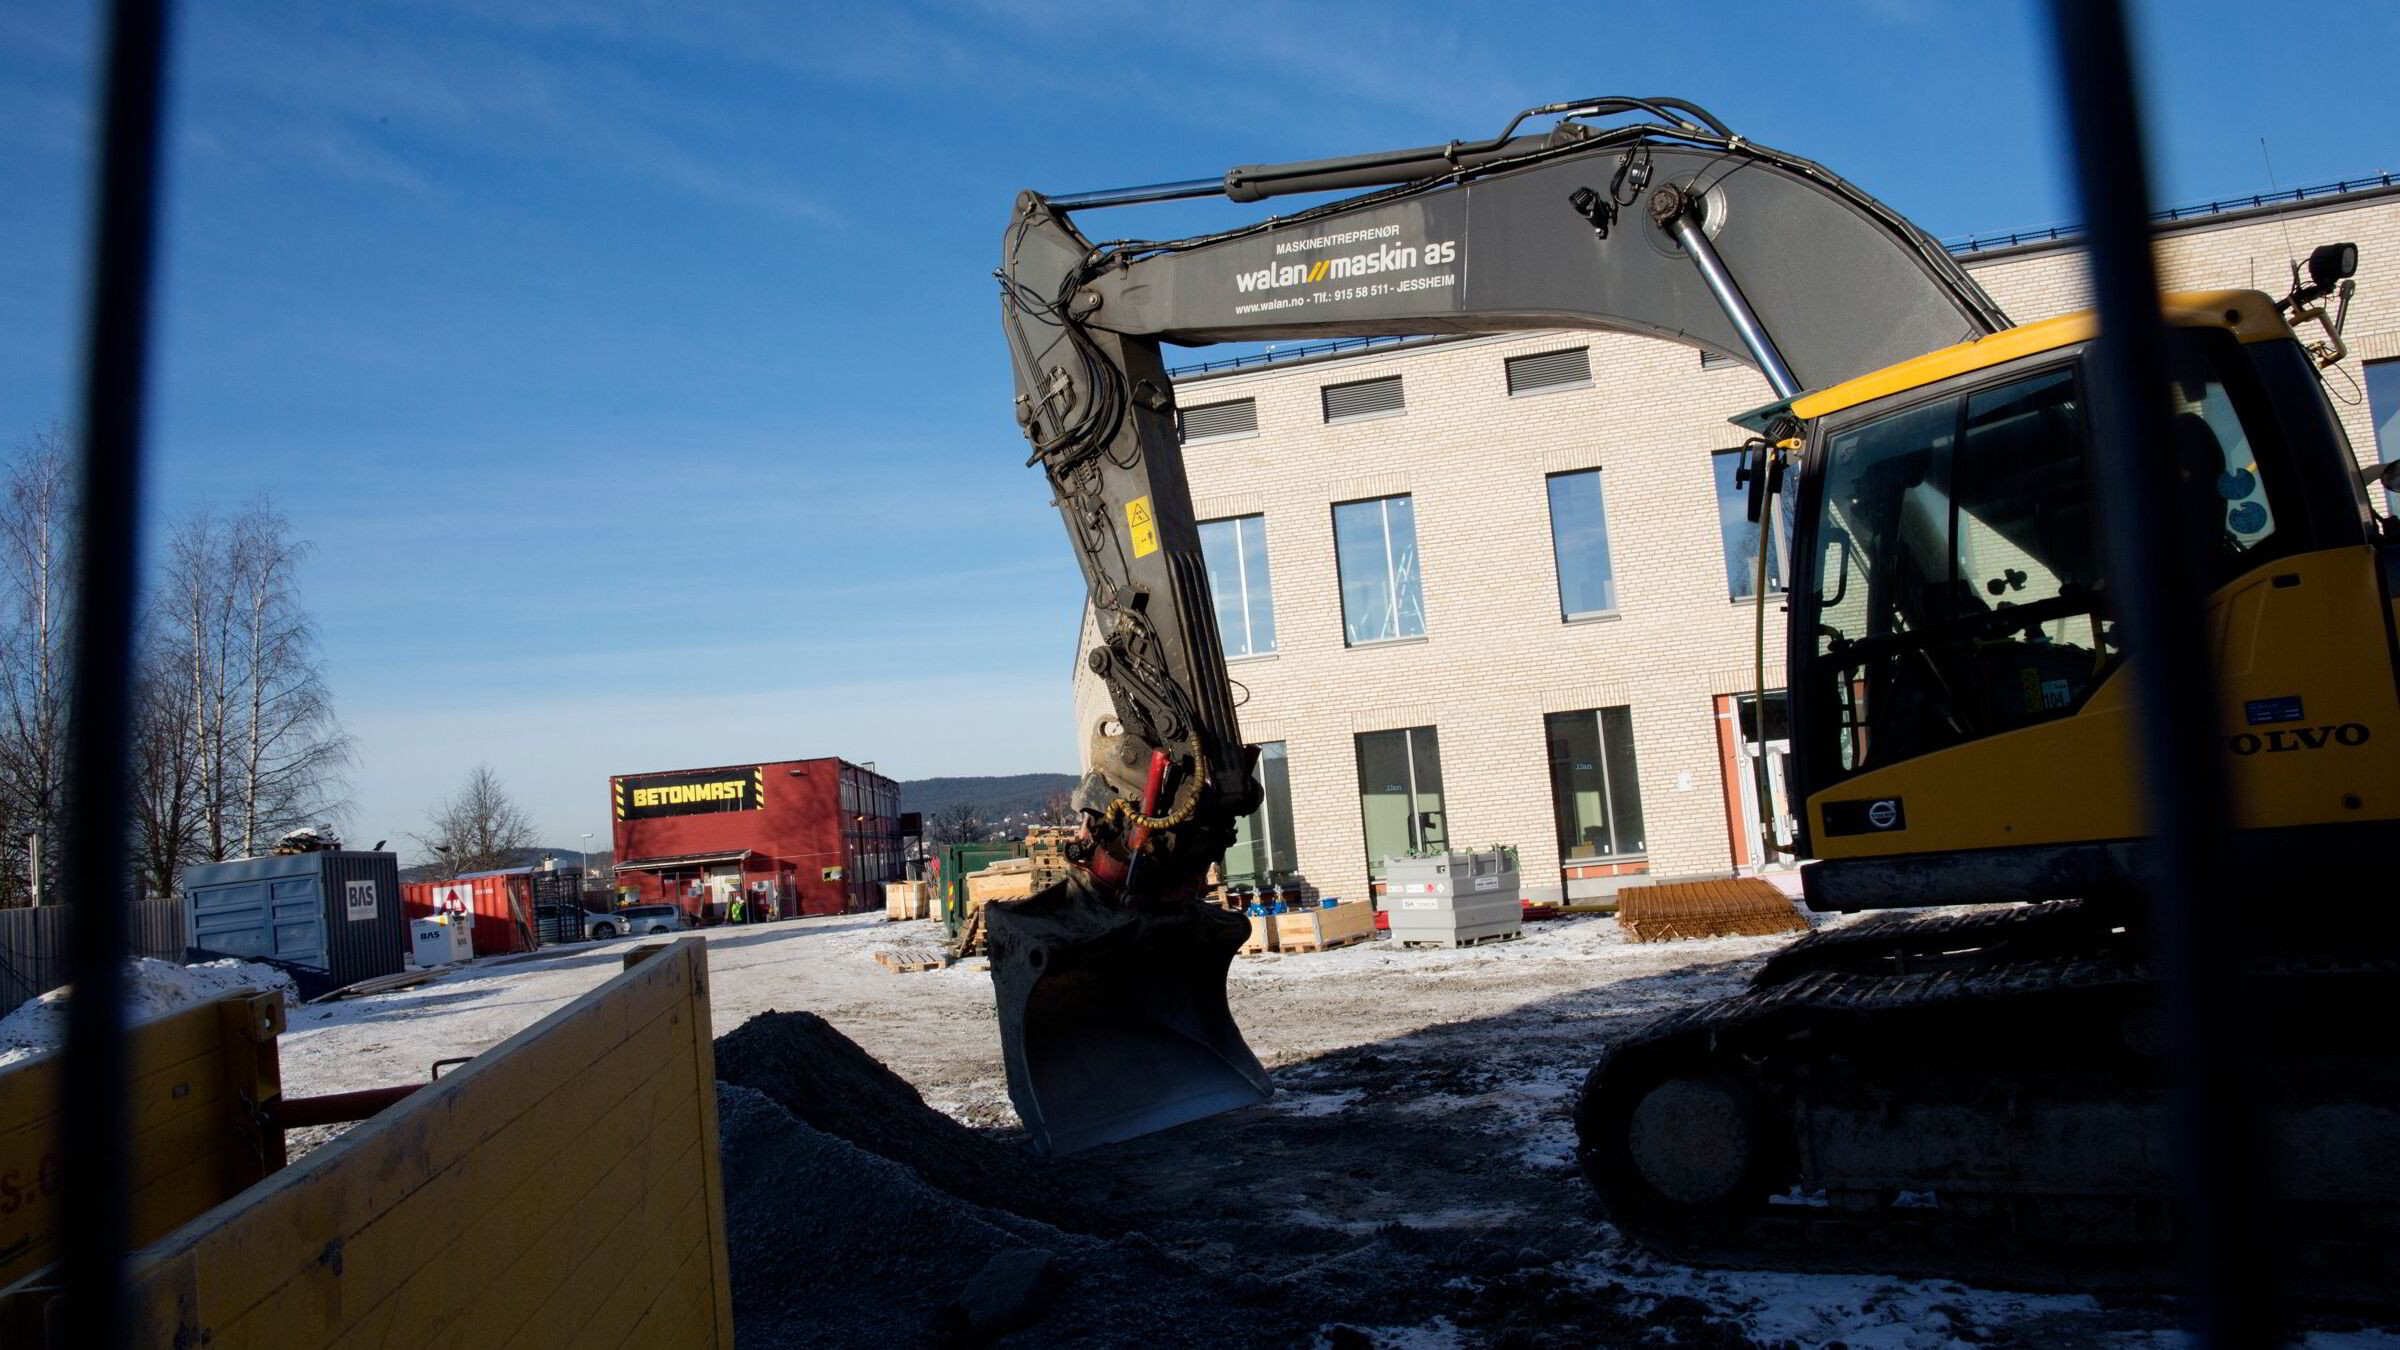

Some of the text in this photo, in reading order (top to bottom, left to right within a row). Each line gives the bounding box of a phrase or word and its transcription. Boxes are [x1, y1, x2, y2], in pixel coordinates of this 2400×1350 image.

[1276, 224, 1400, 255] MASKINENTREPRENØR
[1424, 241, 1456, 265] as
[1235, 297, 1304, 314] www.walan.no
[1334, 288, 1353, 301] 915
[1355, 286, 1368, 298] 58
[1370, 283, 1388, 296] 511
[1396, 274, 1455, 293] JESSHEIM
[2223, 723, 2370, 756] OLVO
[633, 780, 747, 807] BETONMAST
[348, 885, 374, 907] BAS
[420, 930, 440, 940] BAS
